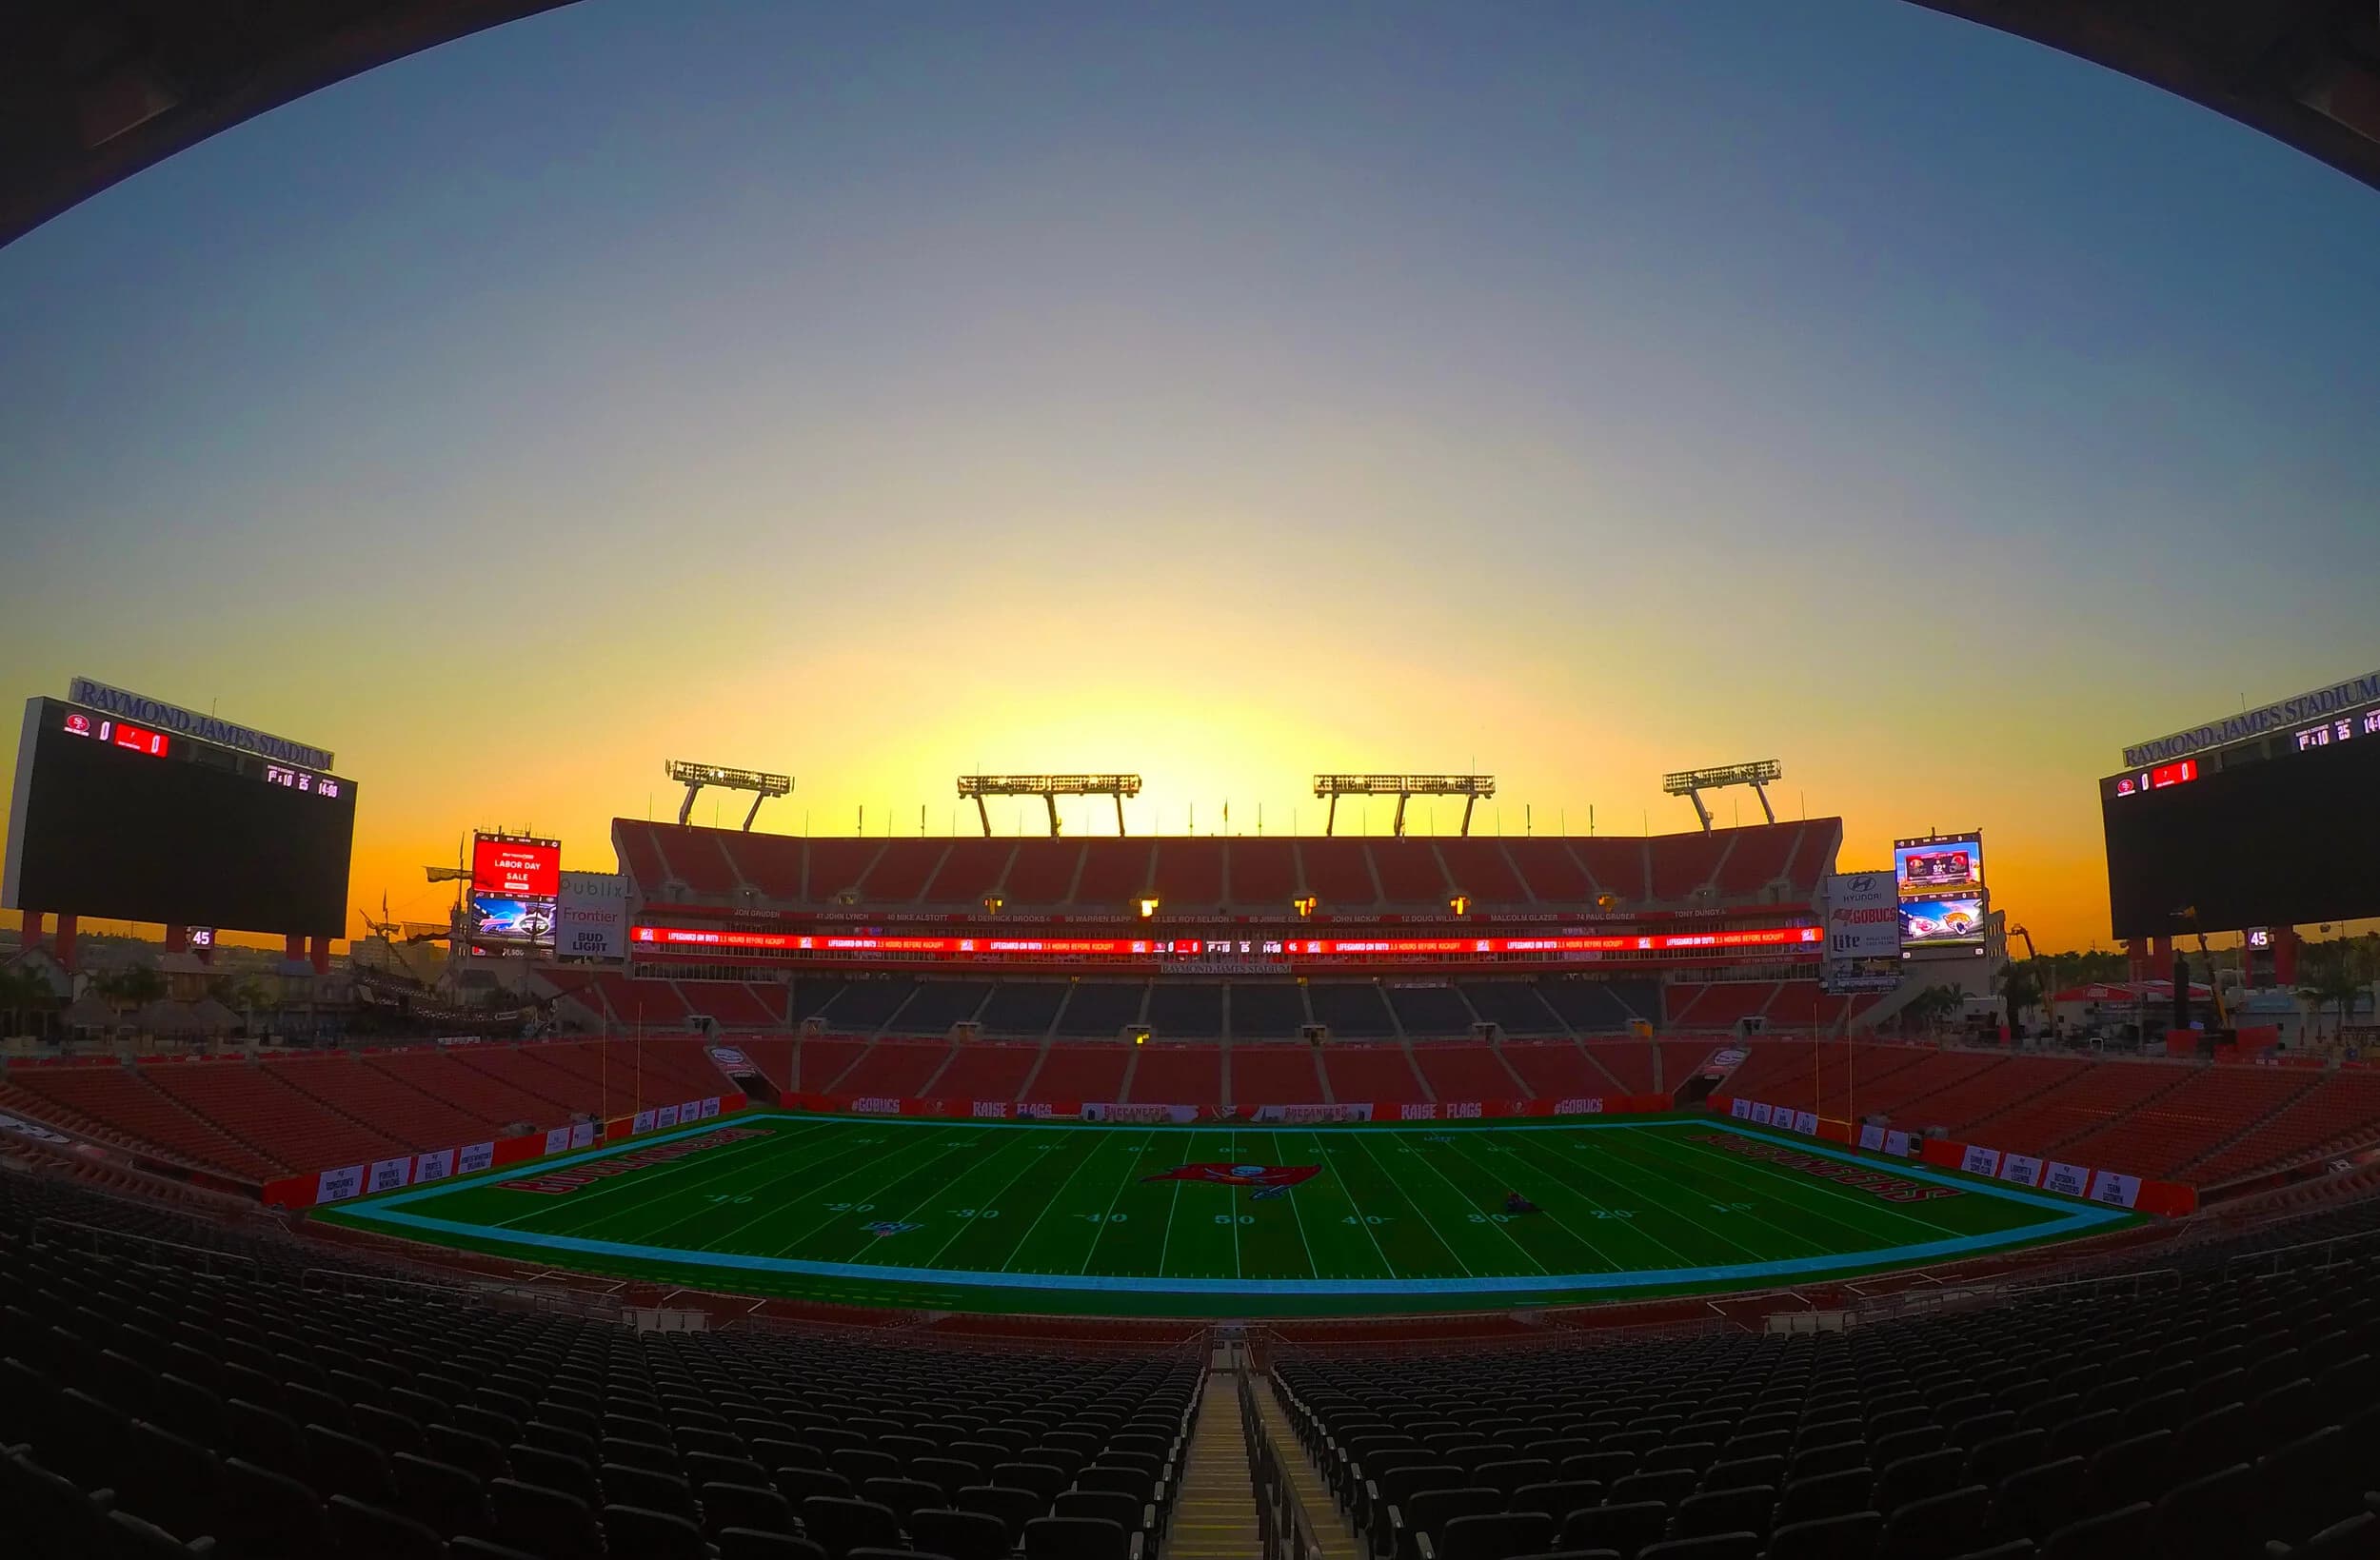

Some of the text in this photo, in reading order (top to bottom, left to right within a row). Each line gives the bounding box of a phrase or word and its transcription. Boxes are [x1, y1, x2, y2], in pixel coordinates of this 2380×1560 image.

[78, 681, 332, 771] RAYMOND JAMES STADIUM
[2125, 675, 2380, 764] RAYMOND JAMES STADIUM
[100, 721, 110, 741] 0
[2318, 729, 2330, 746] 10
[151, 734, 160, 754] 0
[2182, 762, 2190, 780] 0
[284, 774, 293, 787] 10
[2141, 772, 2150, 791] 0
[495, 859, 542, 870] LABOR DAY
[506, 873, 528, 881] SALE
[562, 878, 622, 898] Publix
[1843, 892, 1882, 902] HYUNDAI
[564, 906, 618, 922] Frontier
[192, 931, 210, 945] 45
[578, 932, 604, 942] BUD
[1833, 935, 1860, 952] Lite
[2251, 931, 2268, 945] 45
[572, 941, 607, 952] LIGHT
[1160, 964, 1212, 974] RAYMOND
[852, 1098, 901, 1114] #GOBUCS
[973, 1102, 1007, 1118] RAISE
[1401, 1102, 1482, 1119] RAISE FLAGS
[1554, 1098, 1603, 1116] #GOBUCS
[1214, 1214, 1256, 1225] 50
